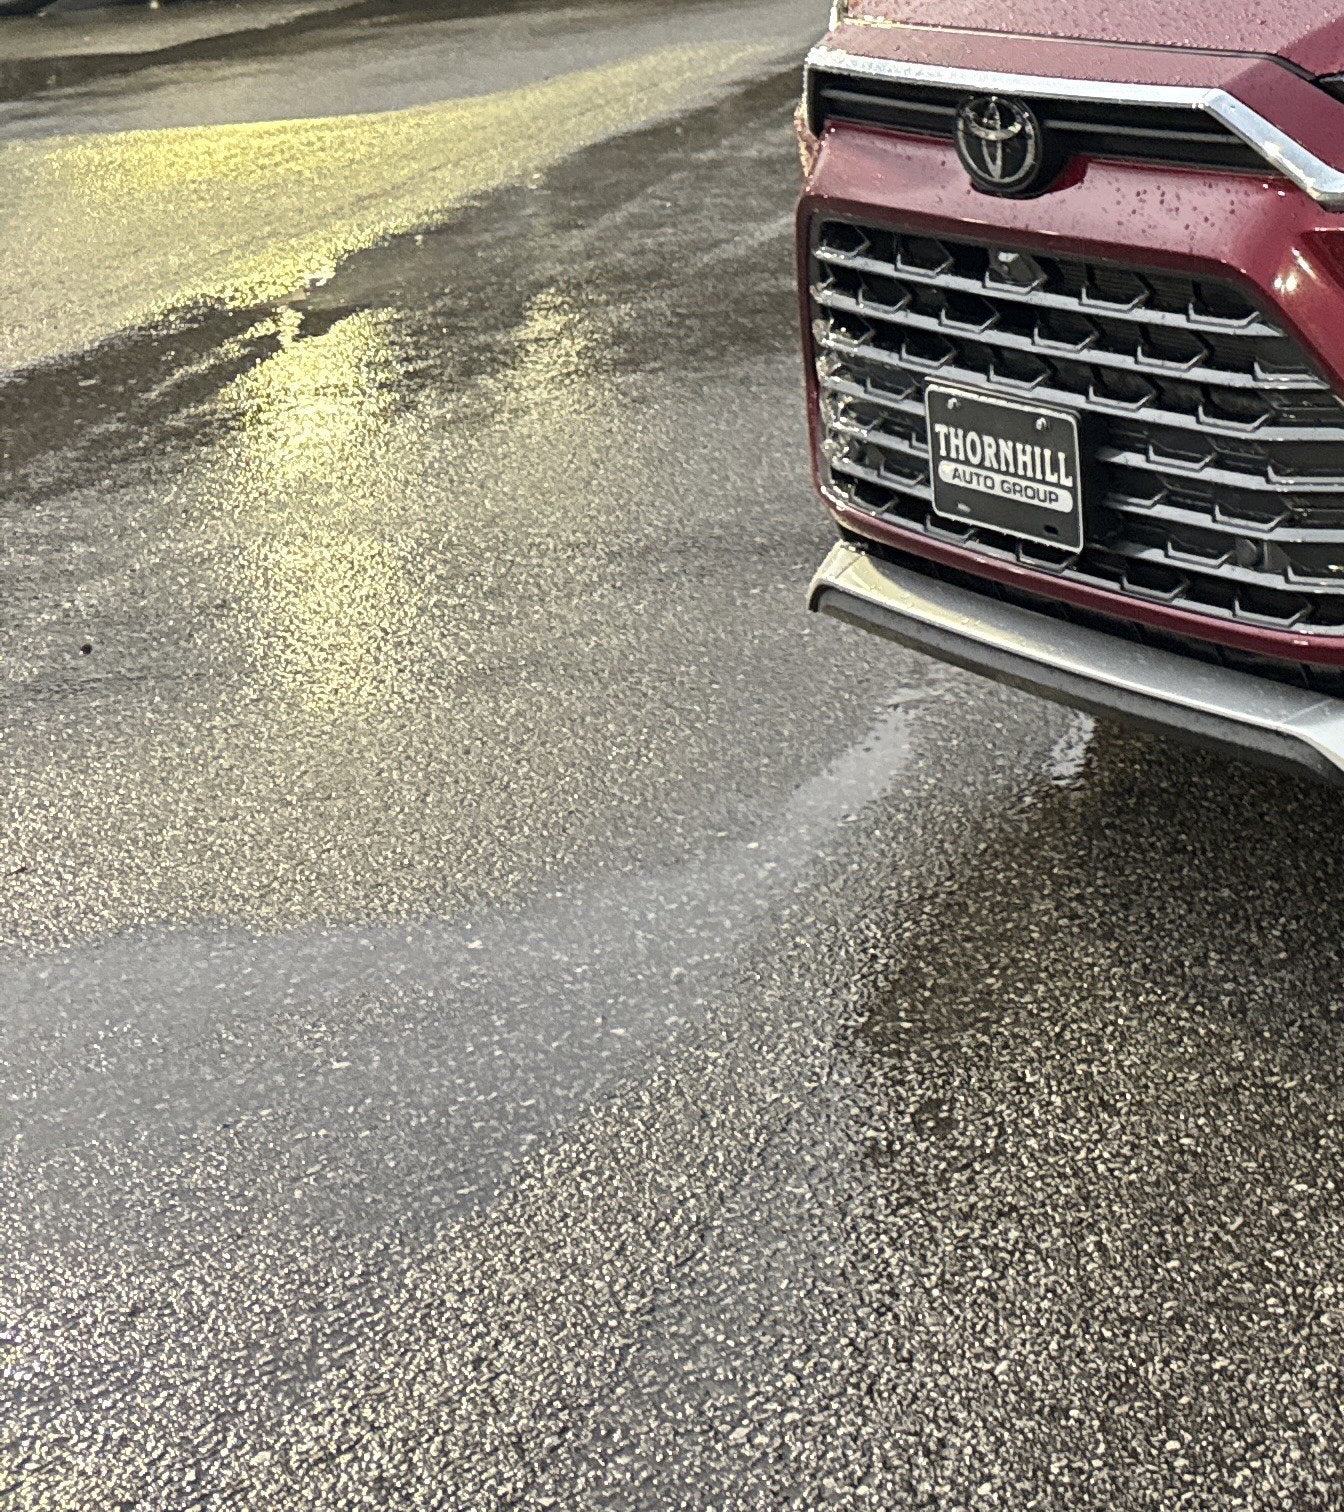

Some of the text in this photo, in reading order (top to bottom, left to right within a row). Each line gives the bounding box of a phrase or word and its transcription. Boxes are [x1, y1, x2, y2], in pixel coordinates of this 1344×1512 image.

[934, 423, 1074, 487] THORNHILL
[952, 467, 1059, 505] AUTO GROUP
